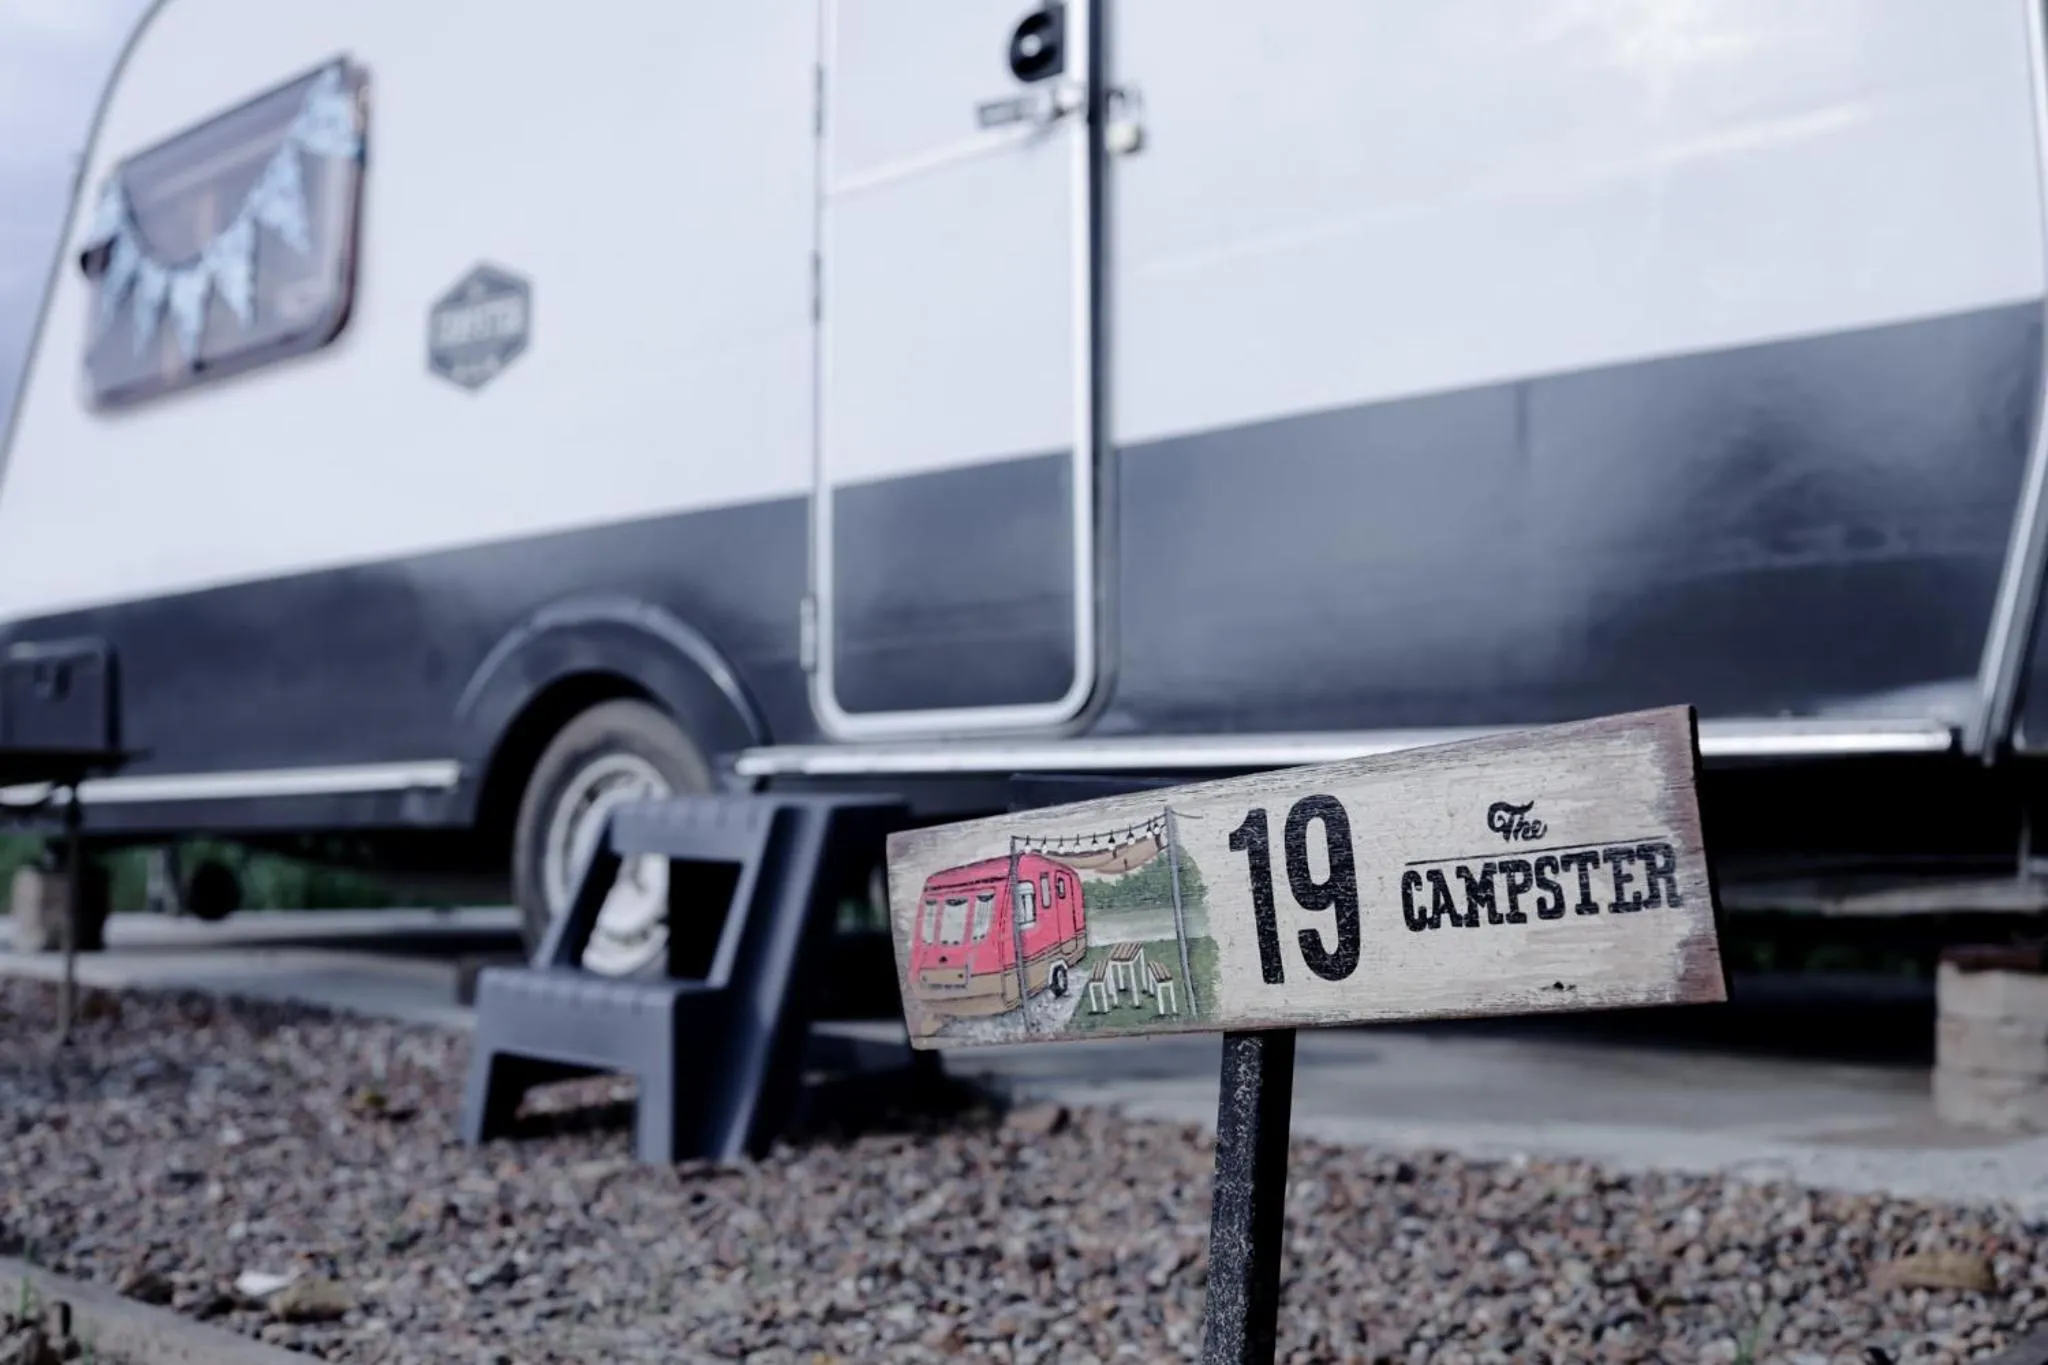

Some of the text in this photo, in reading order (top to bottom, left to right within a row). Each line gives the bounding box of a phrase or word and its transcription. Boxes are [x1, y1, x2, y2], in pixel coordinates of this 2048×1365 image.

[1487, 800, 1548, 842] The
[1229, 794, 1361, 984] 19
[1400, 842, 1683, 932] CAMPSTER
